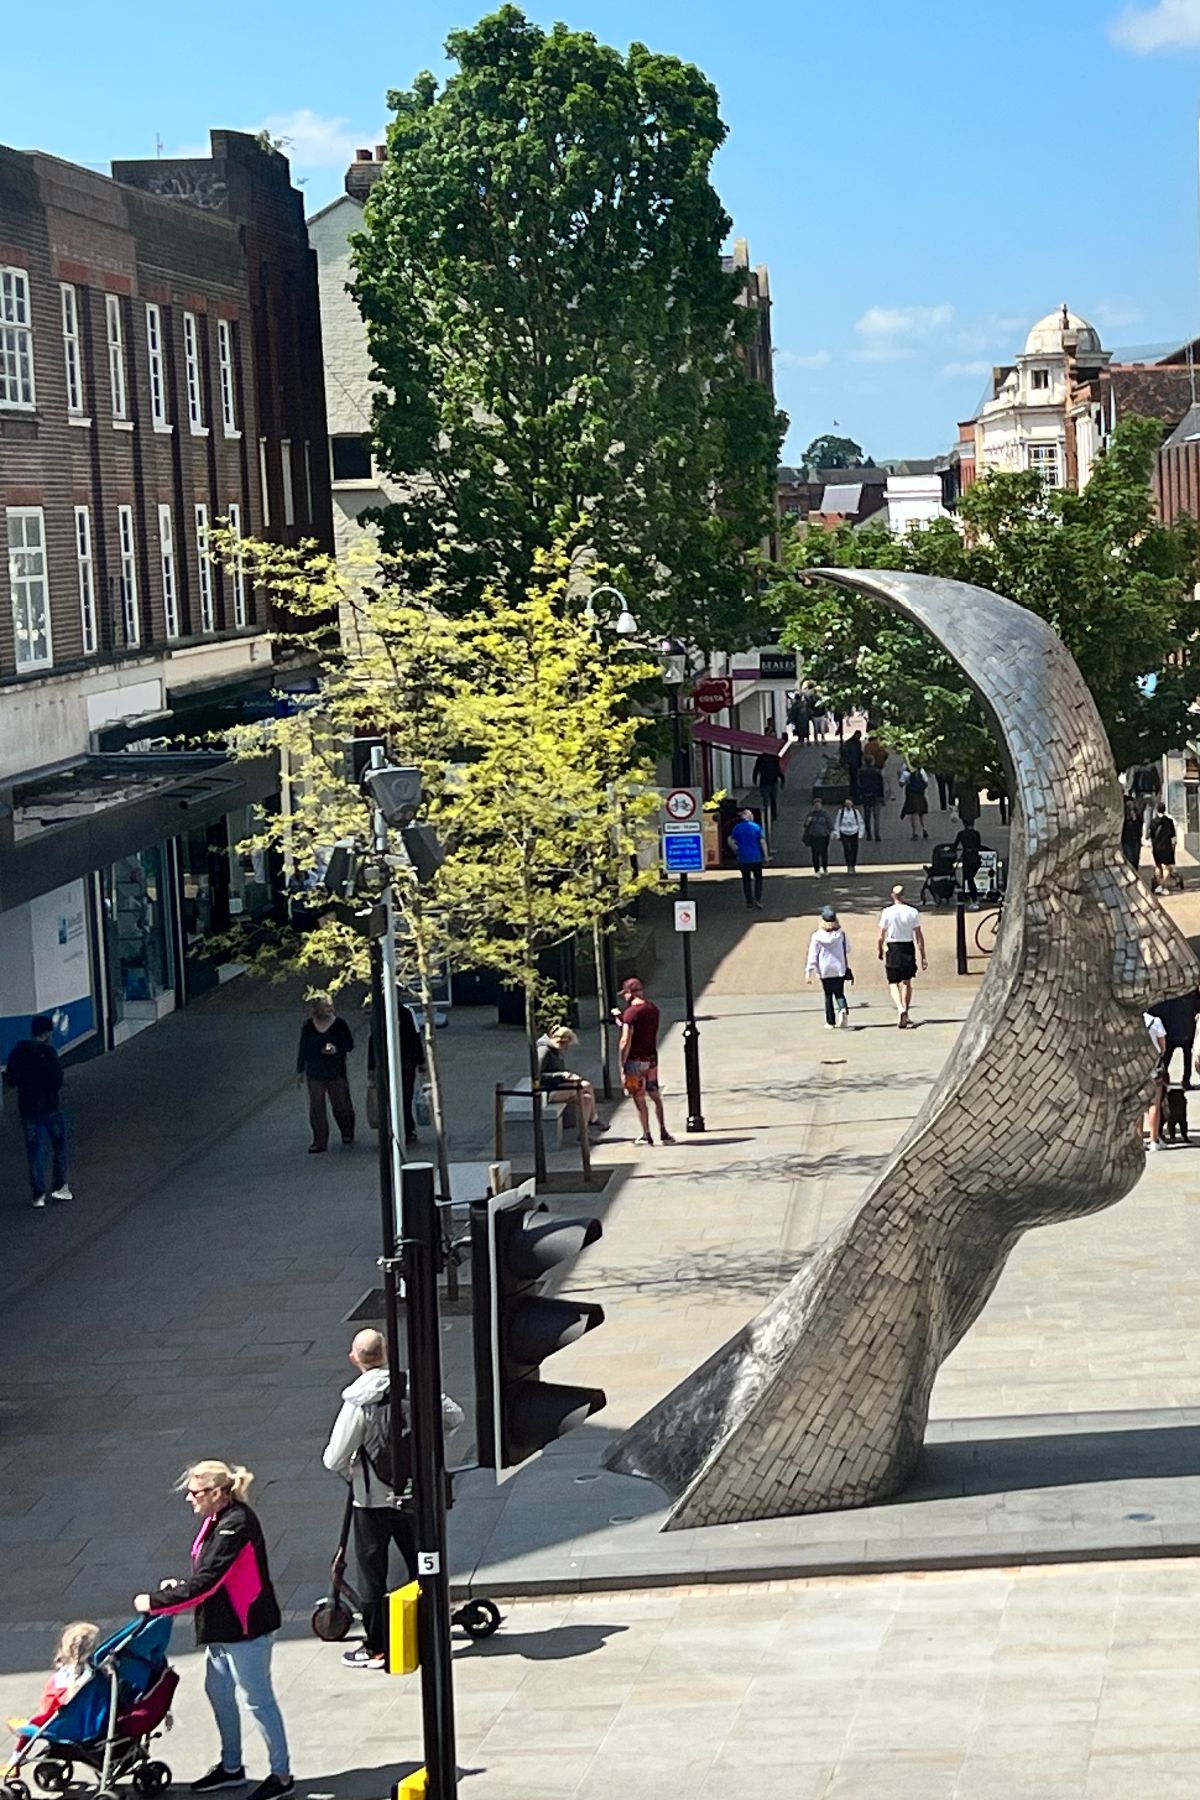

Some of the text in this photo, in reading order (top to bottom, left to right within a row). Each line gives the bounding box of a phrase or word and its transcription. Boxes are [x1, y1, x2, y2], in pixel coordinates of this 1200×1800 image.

[761, 661, 796, 670] BEALES
[698, 695, 724, 703] COSTA
[423, 1556, 434, 1570] 5
